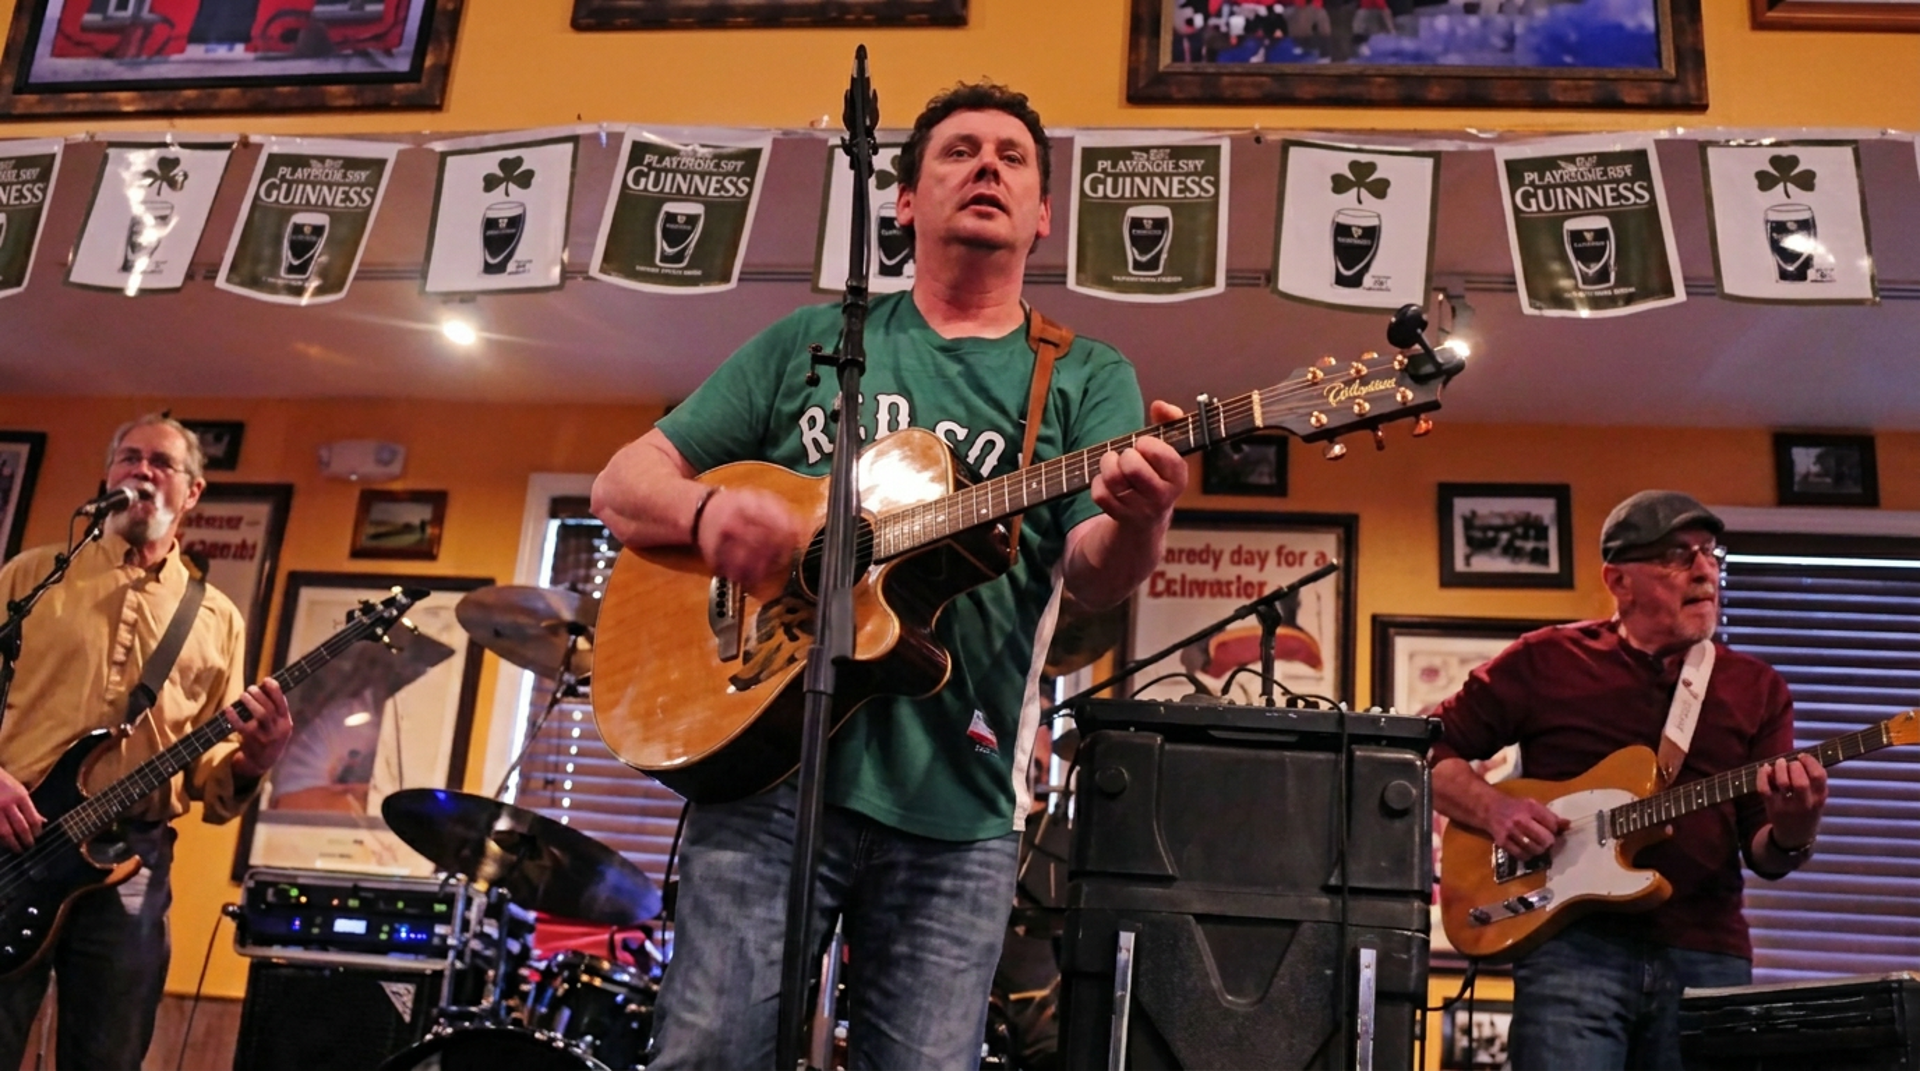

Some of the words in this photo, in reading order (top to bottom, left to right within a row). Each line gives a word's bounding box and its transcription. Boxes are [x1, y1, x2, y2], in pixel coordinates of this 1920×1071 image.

[259, 177, 374, 208] GUINNESS
[626, 165, 751, 197] GUINNESS
[1083, 172, 1215, 198] GUINNESS
[1514, 181, 1650, 212] GUINNESS
[798, 393, 911, 465] RD
[934, 419, 1022, 479] SO
[1229, 544, 1270, 573] day
[1276, 544, 1307, 568] for
[1314, 550, 1328, 567] a
